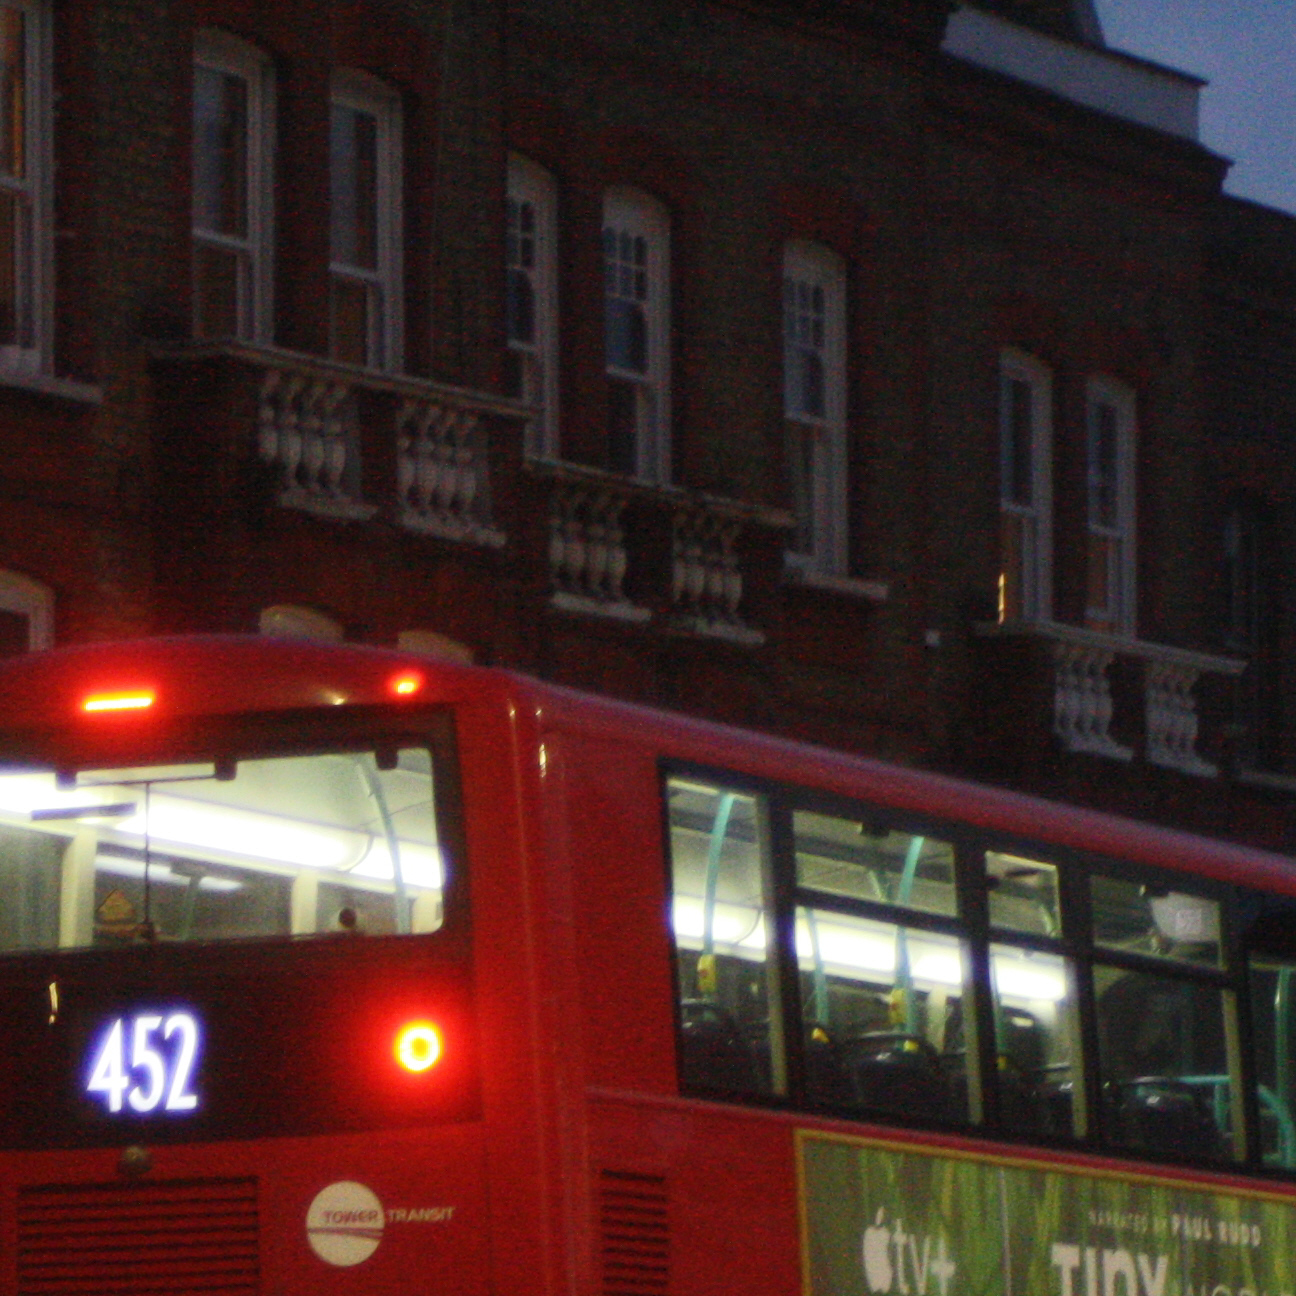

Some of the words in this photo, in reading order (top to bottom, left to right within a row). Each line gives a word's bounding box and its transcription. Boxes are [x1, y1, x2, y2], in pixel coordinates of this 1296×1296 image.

[87, 1013, 201, 1113] 452
[323, 1210, 379, 1223] TOWER
[388, 1207, 455, 1223] TRANSIT
[1171, 1213, 1212, 1241] PAUL
[1218, 1220, 1262, 1247] RUDD
